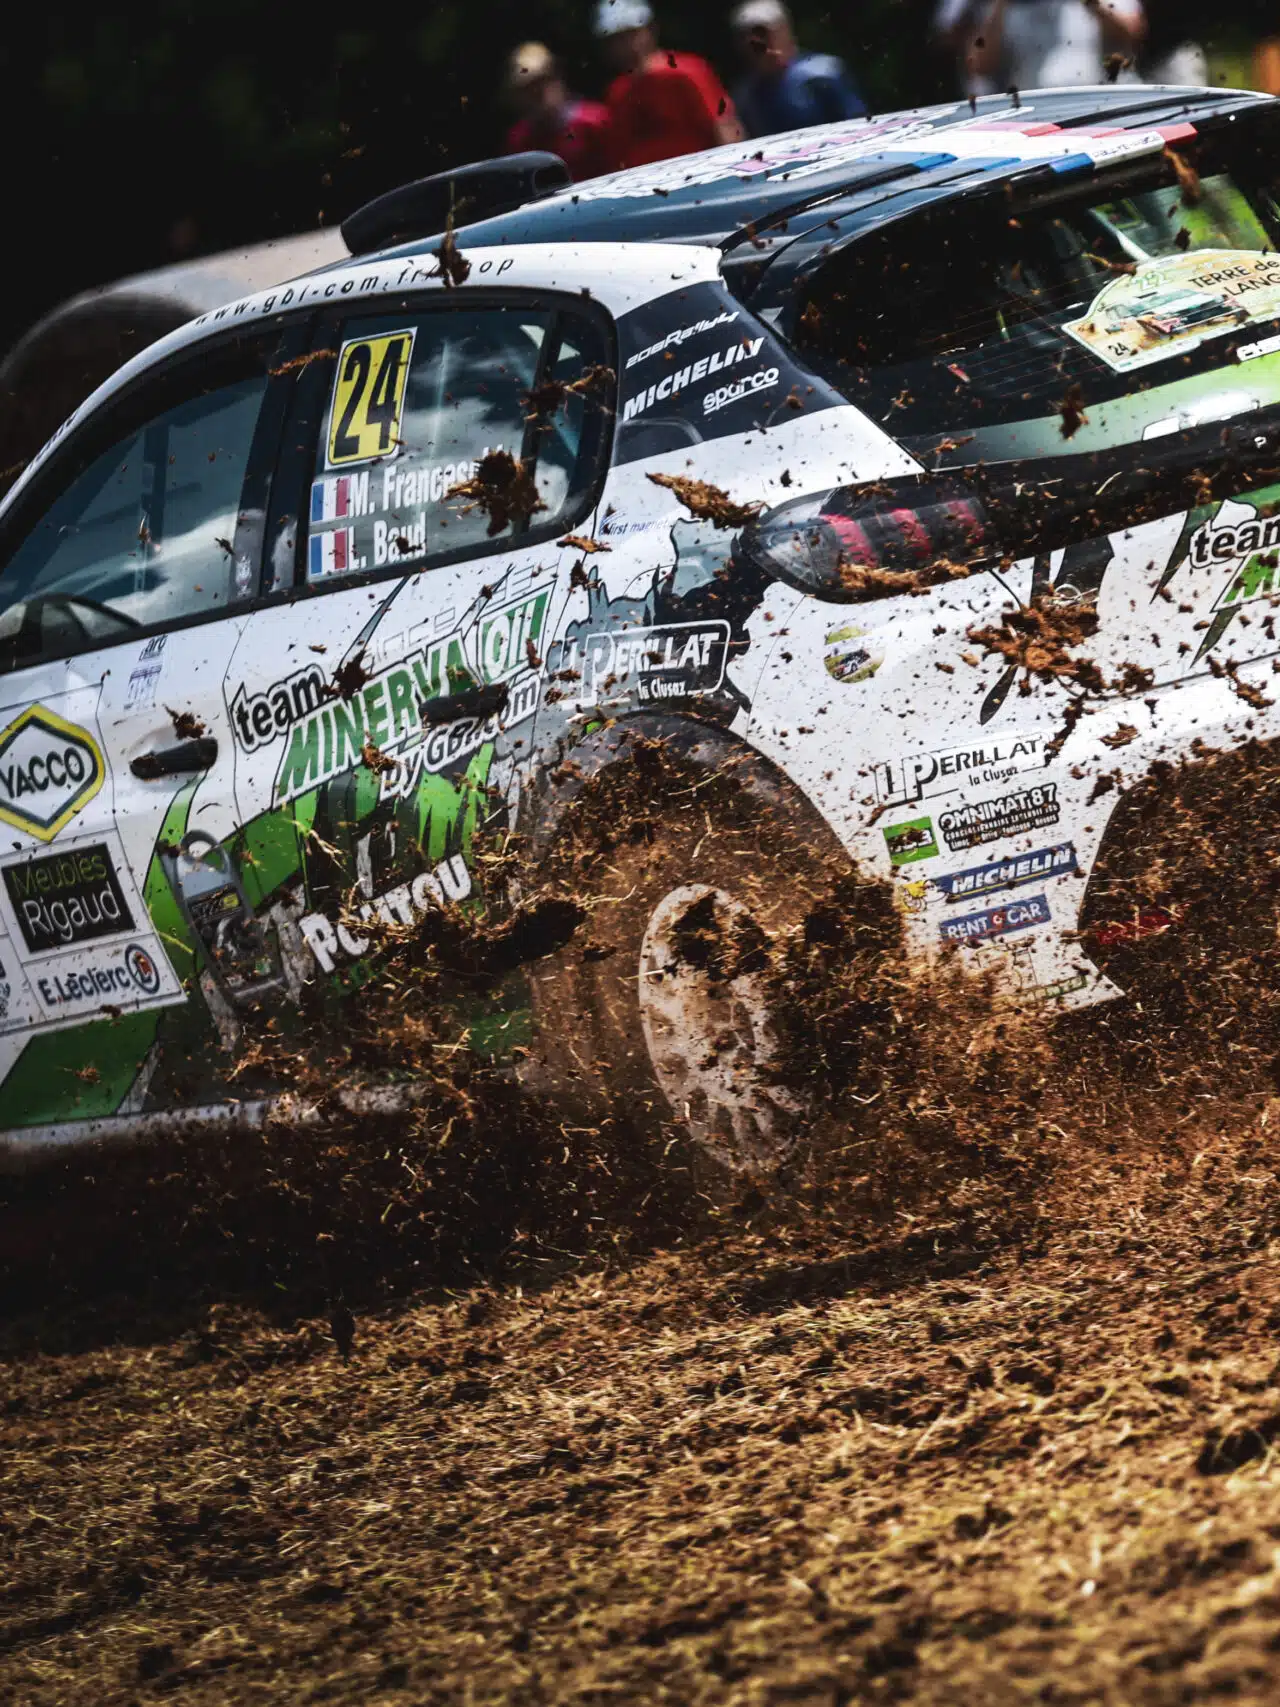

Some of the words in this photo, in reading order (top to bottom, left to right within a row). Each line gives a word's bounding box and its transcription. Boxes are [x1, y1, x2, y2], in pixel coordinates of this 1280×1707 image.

[1188, 264, 1250, 289] TERRE
[1253, 259, 1280, 273] de
[1107, 341, 1129, 357] 24
[333, 337, 406, 459] 24
[622, 336, 766, 421] MICHELIN
[703, 367, 780, 412] sparco
[350, 471, 375, 518] M.
[236, 671, 324, 747] team
[276, 638, 480, 800] MINERVA
[484, 596, 541, 680] OIL
[1, 746, 86, 800] YACCO
[983, 766, 1018, 783] Clusaz
[1031, 784, 1057, 807] 87
[11, 851, 108, 899] Meubles
[951, 848, 1071, 894] MICHELIN
[22, 881, 122, 942] Rigaud
[947, 916, 988, 940] RENT
[1006, 902, 1042, 924] CAR
[38, 964, 131, 1007] E.Leclerc
